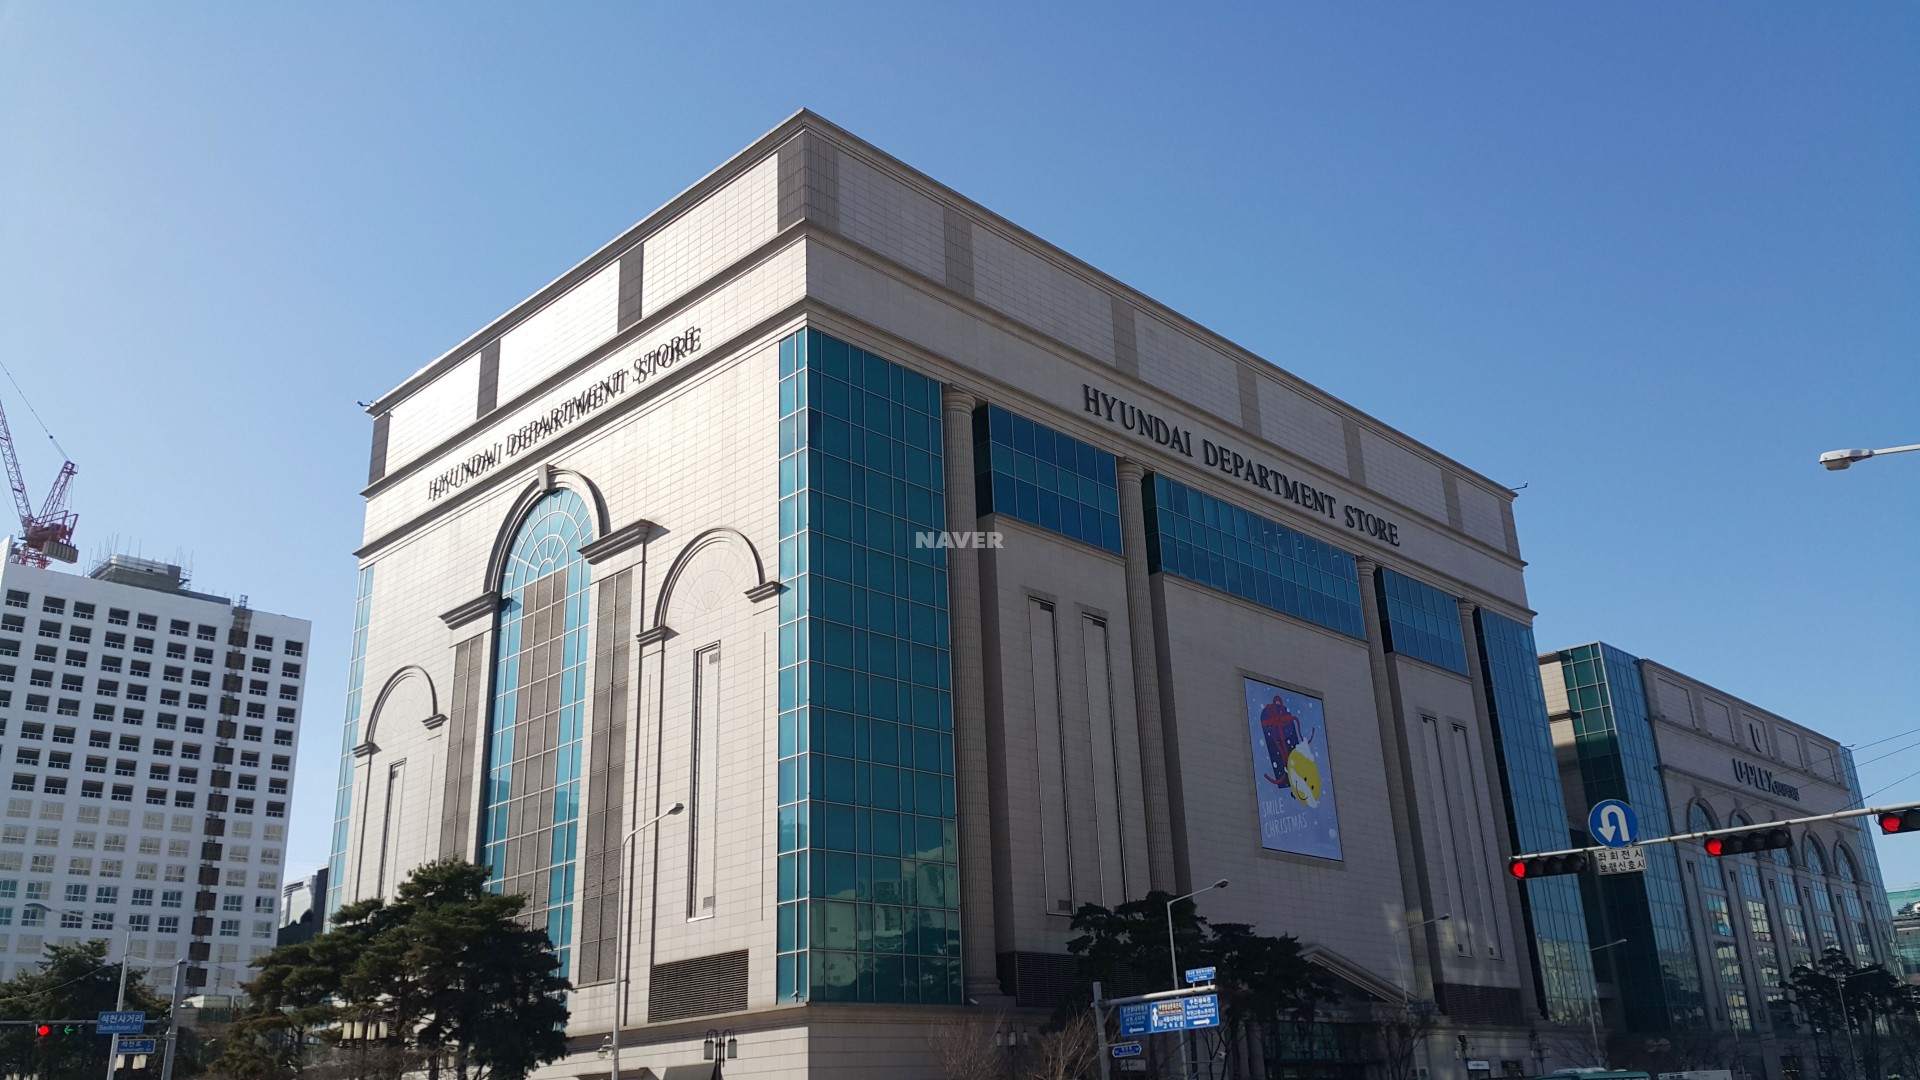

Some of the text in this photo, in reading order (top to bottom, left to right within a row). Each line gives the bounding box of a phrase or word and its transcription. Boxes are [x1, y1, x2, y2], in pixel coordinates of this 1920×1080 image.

[428, 326, 703, 502] HYUNDAI DEPARTMENT STORE
[1083, 383, 1401, 548] HYUNDAI DEPARTMENT STORE
[1262, 798, 1285, 817] SMILE
[1264, 812, 1307, 838] CHRISTMAS
[1600, 859, 1646, 873] 보행신호시
[101, 1014, 143, 1024] 석천사거리
